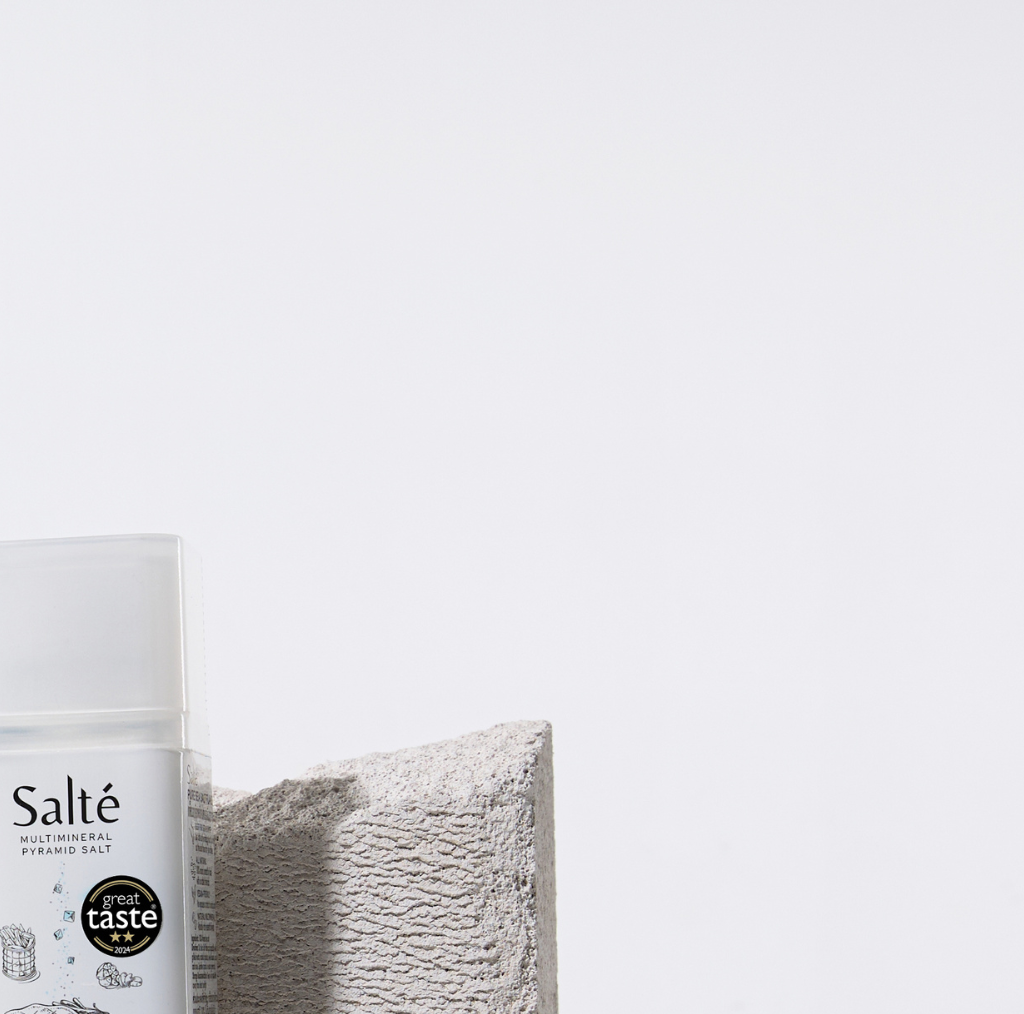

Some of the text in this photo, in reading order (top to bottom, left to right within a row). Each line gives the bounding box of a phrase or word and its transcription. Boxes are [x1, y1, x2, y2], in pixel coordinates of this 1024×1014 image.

[12, 774, 120, 827] Salté
[20, 832, 113, 844] MULTIMINERAL
[21, 844, 112, 856] PYRAMID SALT
[103, 892, 140, 909] great
[86, 907, 158, 929] taste
[114, 946, 131, 954] 2024
